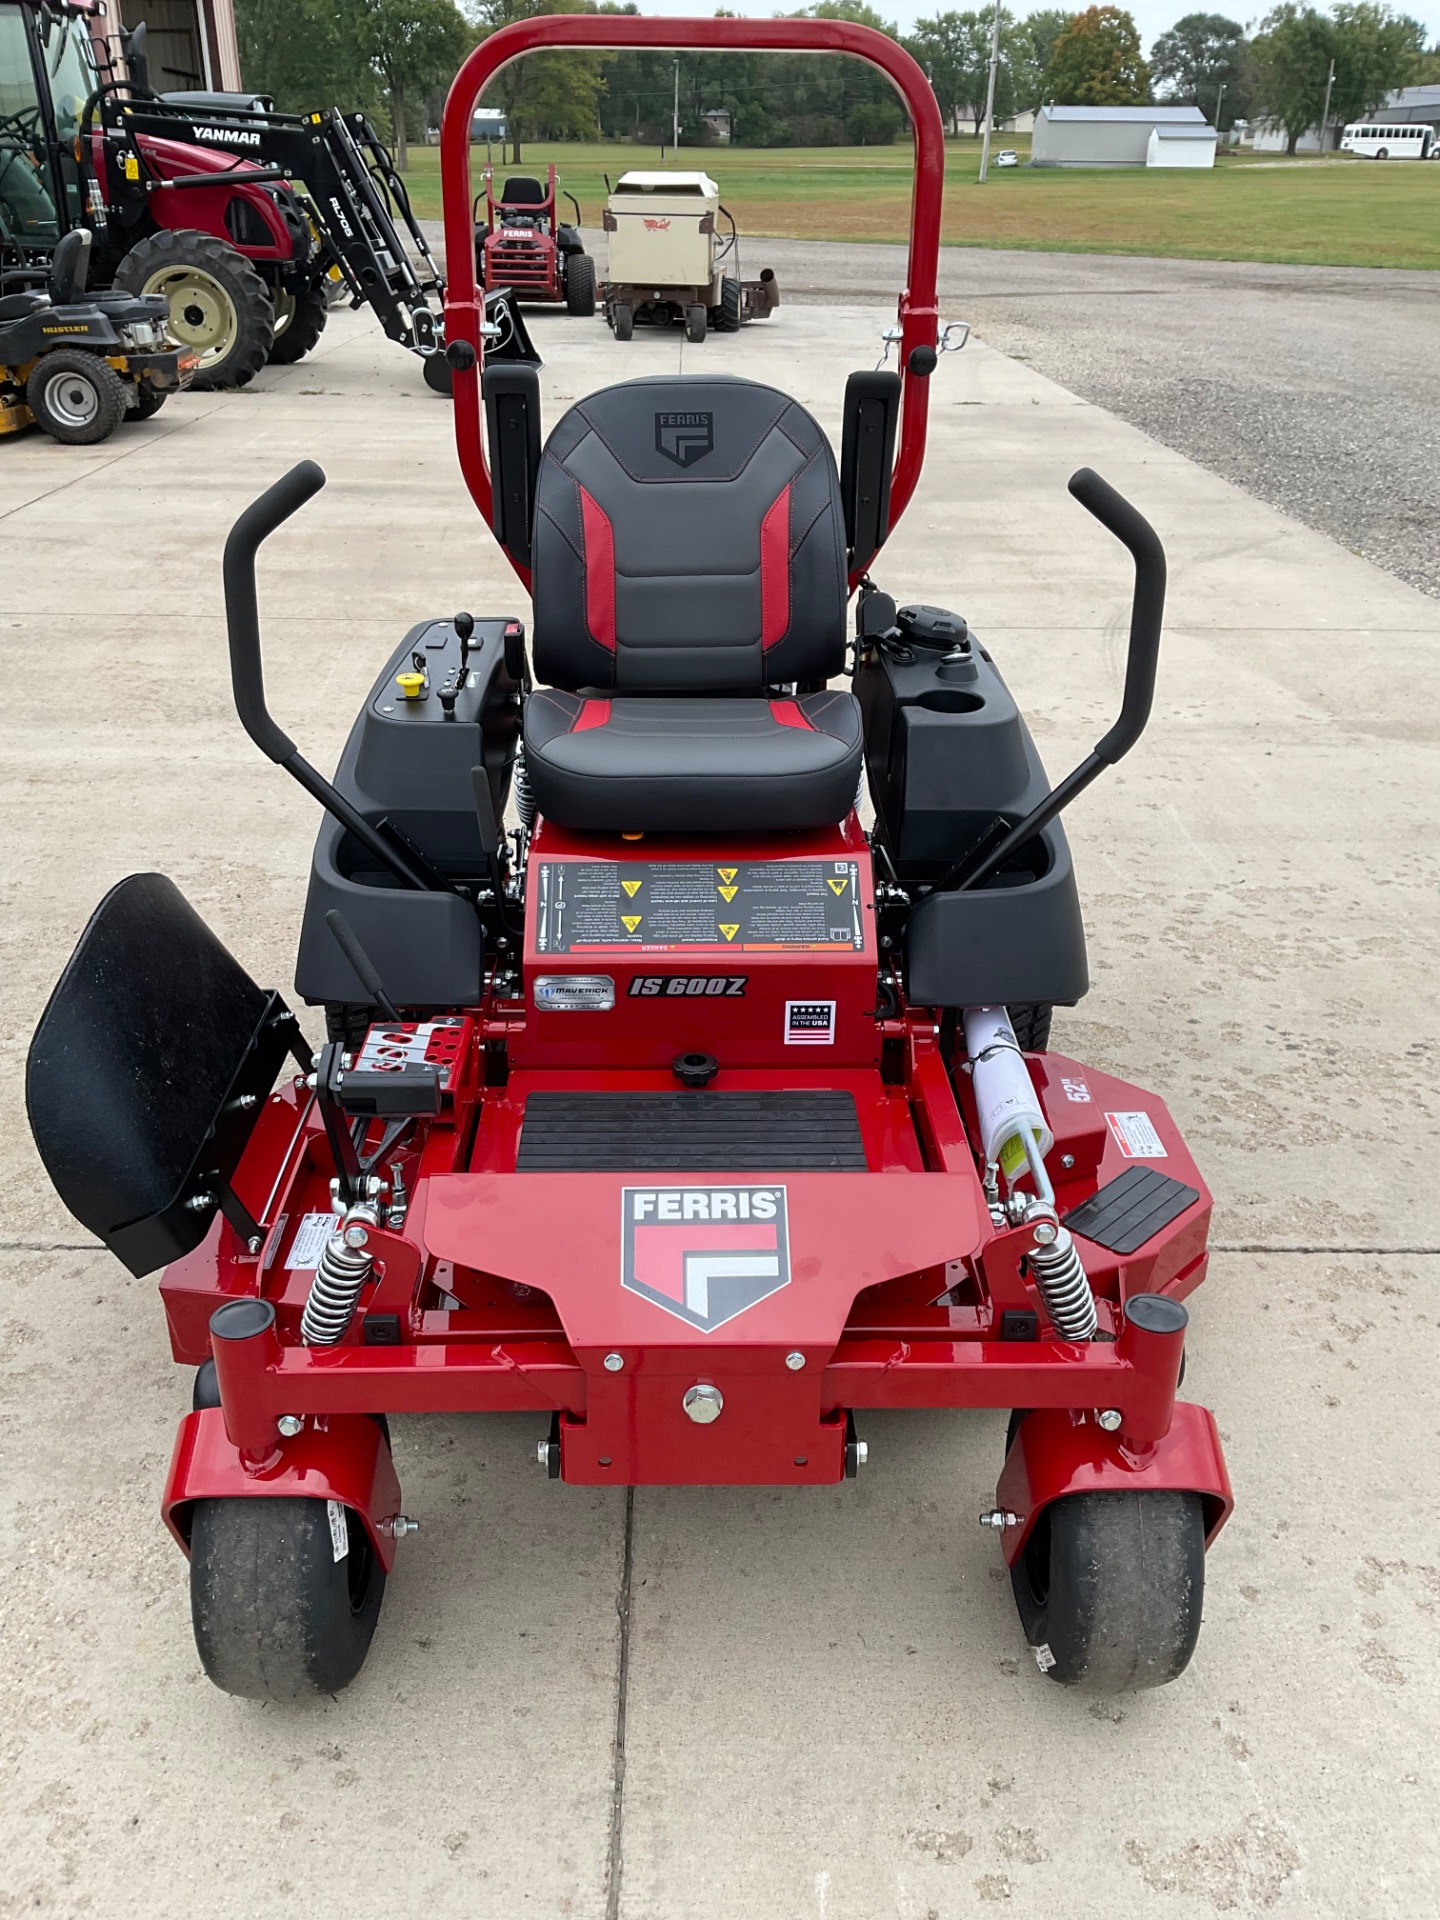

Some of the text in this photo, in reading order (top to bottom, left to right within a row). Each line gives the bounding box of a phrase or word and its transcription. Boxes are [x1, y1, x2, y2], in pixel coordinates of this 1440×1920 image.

[192, 126, 261, 145] YANMAR
[328, 197, 354, 237] RL705
[503, 229, 533, 238] FERRIS
[42, 325, 89, 334] HUSTLER
[660, 414, 709, 425] FERRIS
[630, 978, 747, 995] IS 600Z
[633, 1191, 777, 1220] FERRIS
